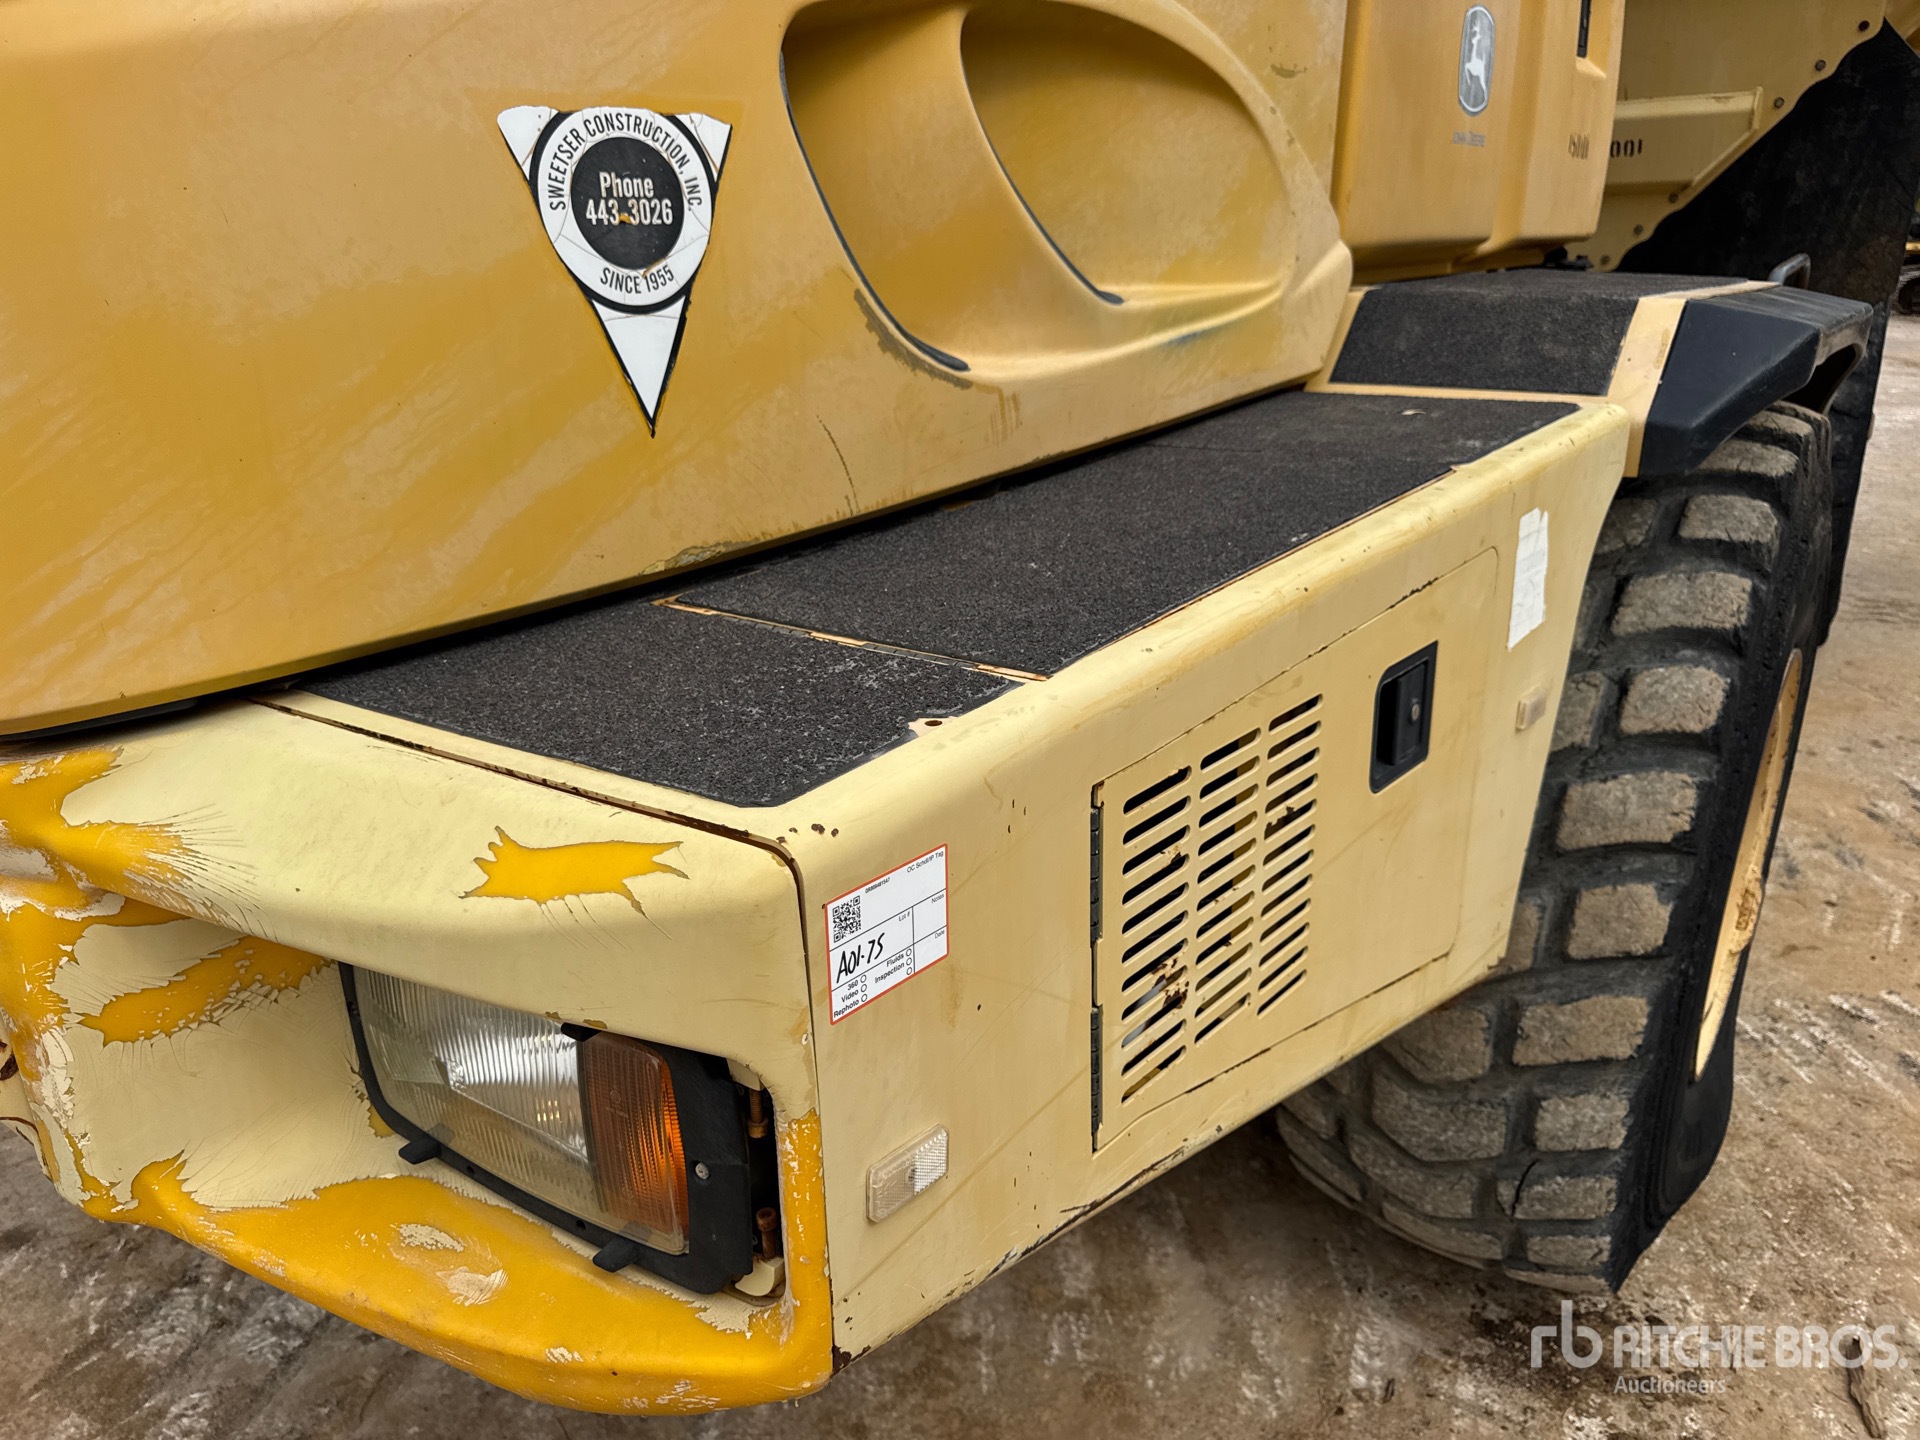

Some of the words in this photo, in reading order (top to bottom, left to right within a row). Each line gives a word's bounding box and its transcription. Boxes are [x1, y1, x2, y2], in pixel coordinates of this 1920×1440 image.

[548, 128, 586, 210] SWEETSER
[583, 112, 691, 175] CONSTRUCTION,
[684, 177, 702, 211] INC.
[599, 172, 654, 198] Phone
[585, 199, 673, 226] 443-3026
[600, 268, 642, 294] SINCE
[644, 265, 675, 293] 1955
[931, 894, 945, 904] Notes
[898, 913, 907, 922] Lot
[934, 929, 945, 939] Date
[886, 952, 904, 967] Fluids
[875, 962, 905, 984] Inspection
[847, 980, 859, 991] 360
[841, 989, 859, 1003] Video
[833, 999, 860, 1018] Rephoto
